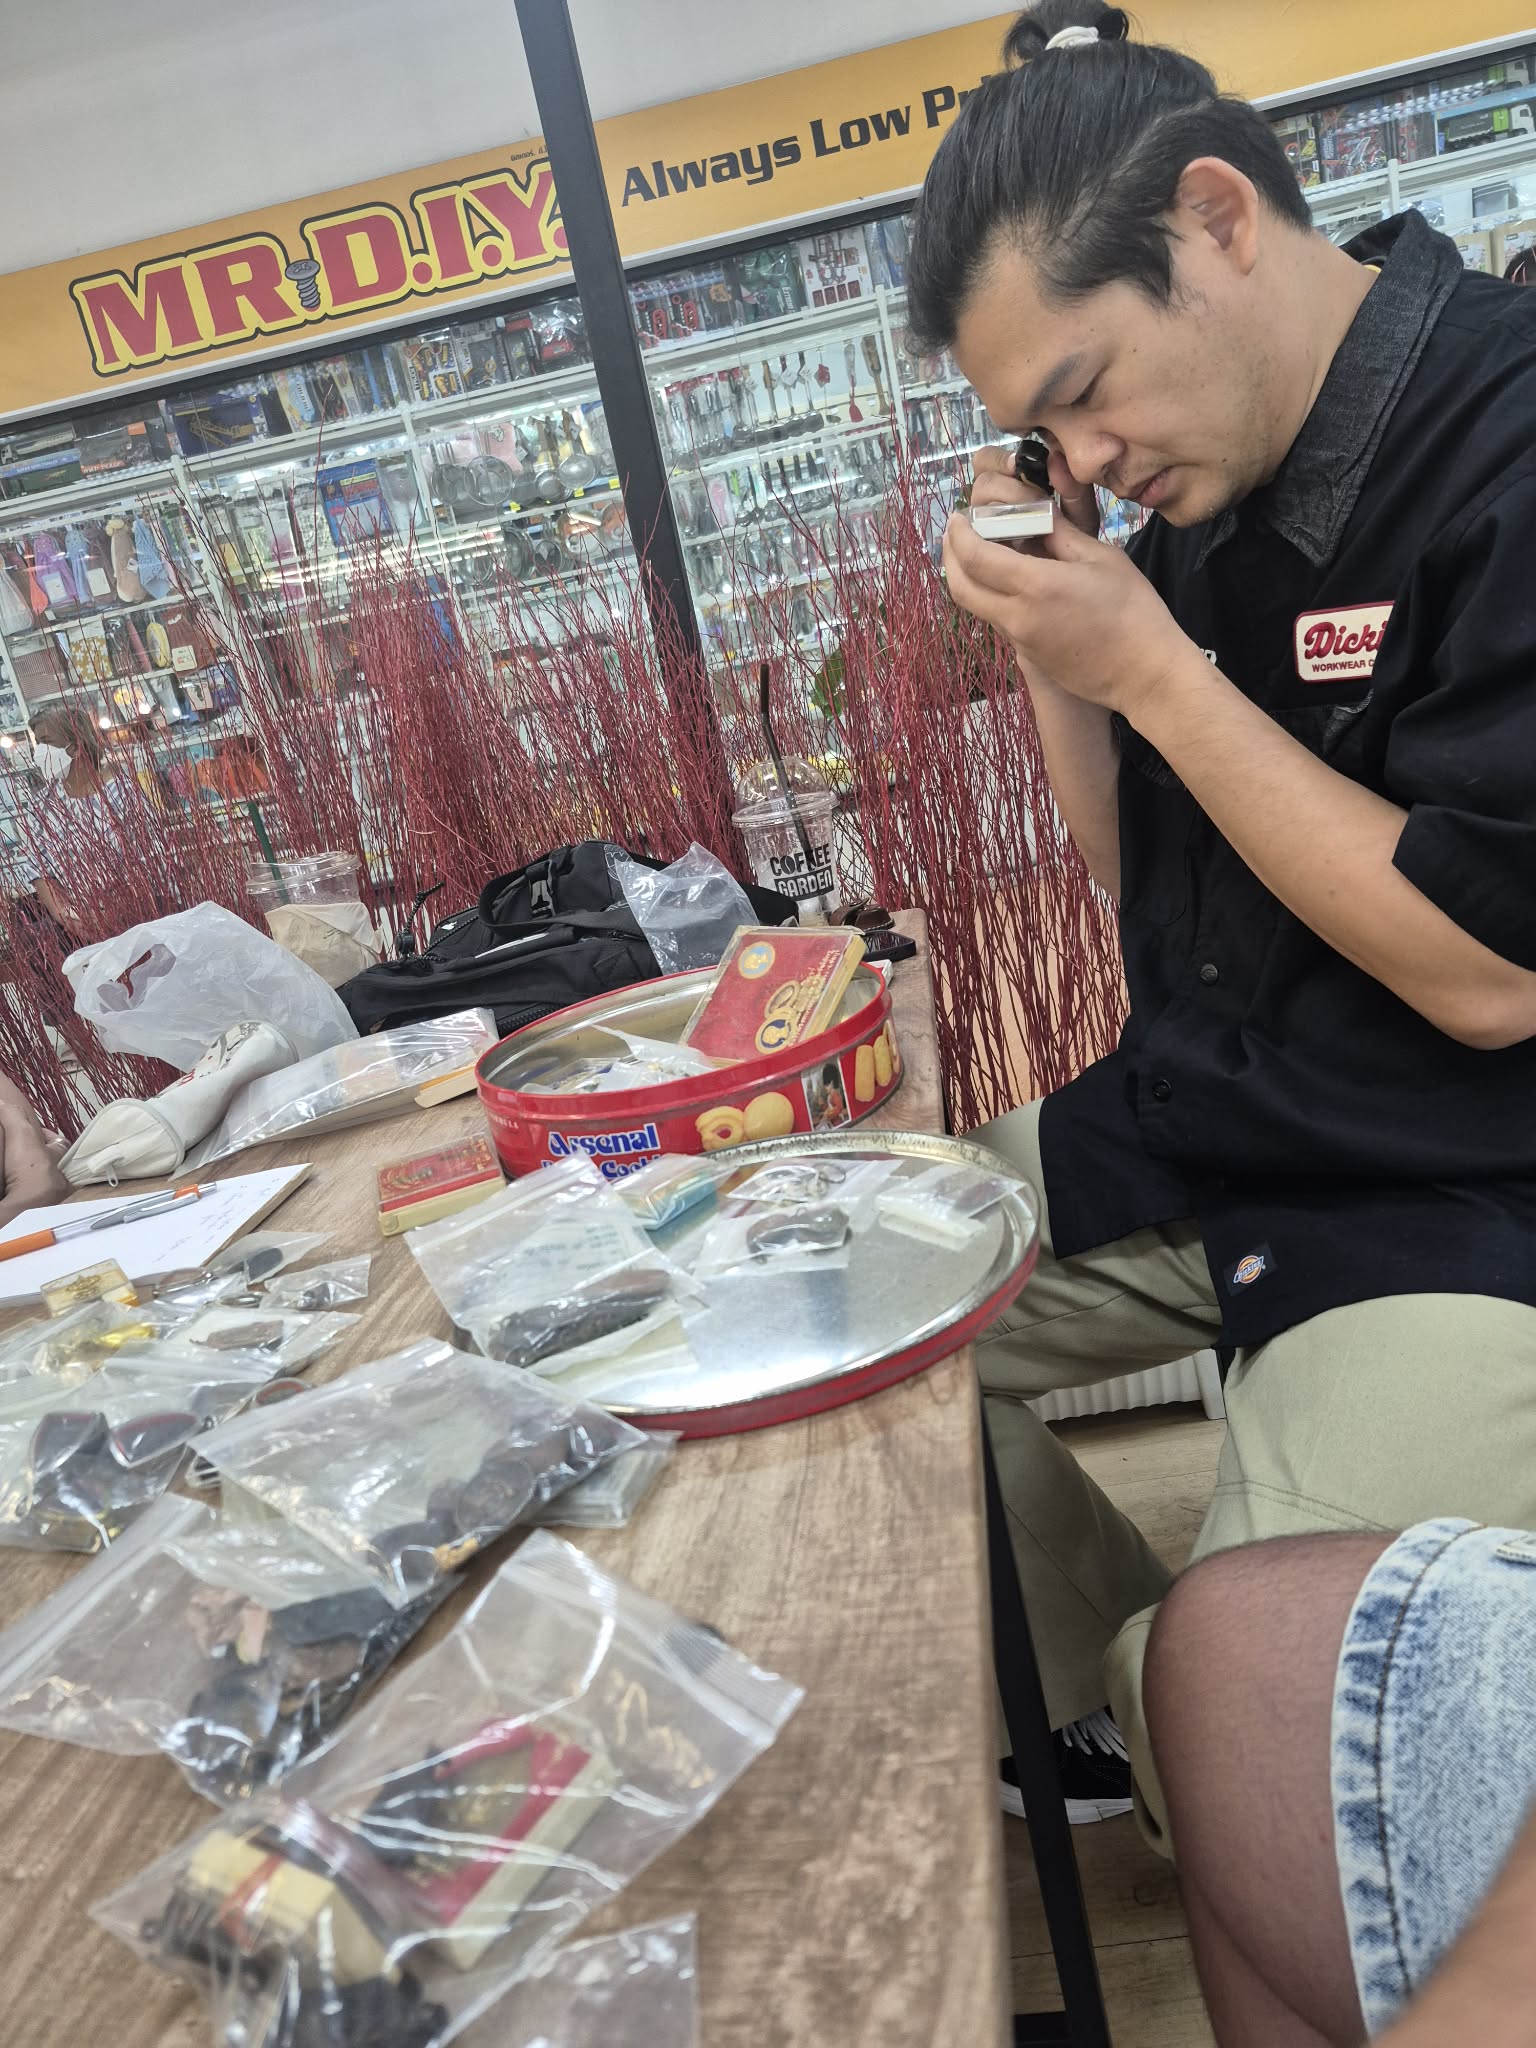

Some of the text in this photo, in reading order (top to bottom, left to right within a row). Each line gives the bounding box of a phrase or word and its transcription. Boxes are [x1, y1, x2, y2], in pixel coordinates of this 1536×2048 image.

[621, 135, 801, 208] Always
[808, 105, 911, 158] Low
[1311, 659, 1366, 673] WORKWEAR
[777, 869, 832, 898] GARDEN
[549, 1123, 661, 1158] Arsenal
